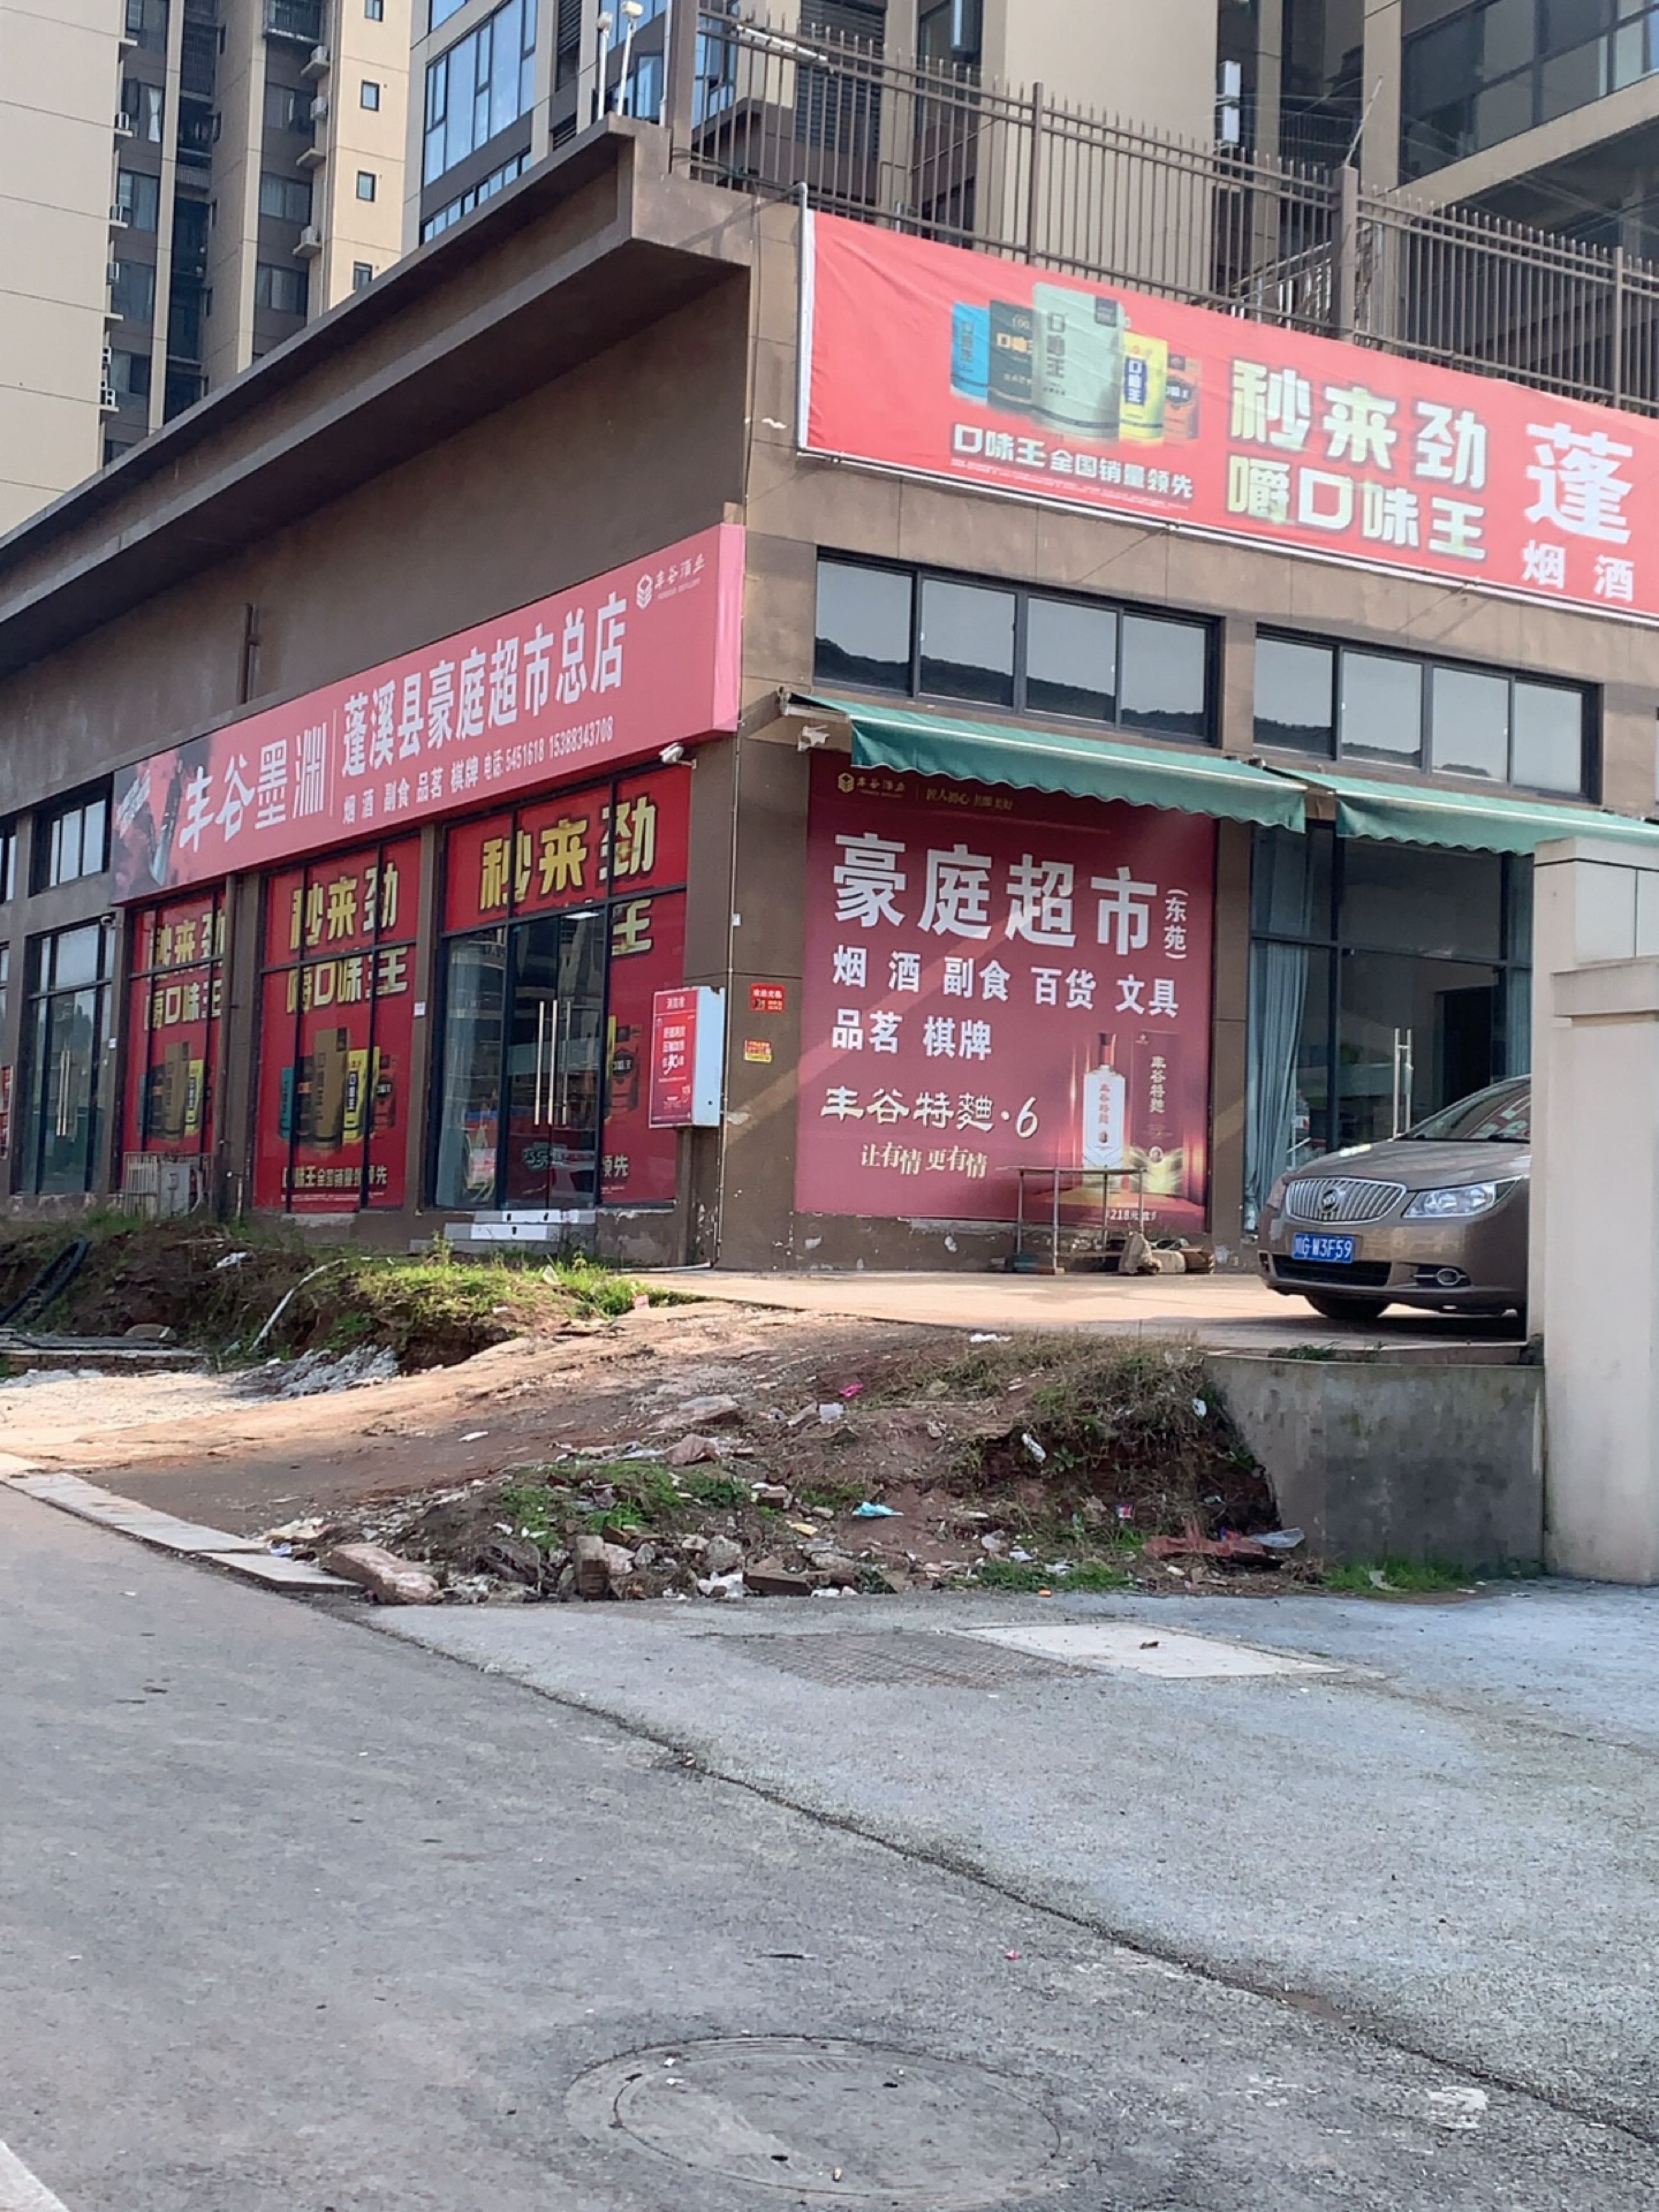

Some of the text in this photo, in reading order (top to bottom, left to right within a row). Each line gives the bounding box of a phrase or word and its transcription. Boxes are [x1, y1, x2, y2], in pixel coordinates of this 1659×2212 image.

[954, 423, 1194, 499] 口味王全国销量领先
[1231, 358, 1487, 489] 秒来劲
[1525, 422, 1633, 544] 蓬
[1228, 455, 1486, 560] 嚼口味王
[342, 591, 627, 778] 蓬溪县豪庭超市总店
[480, 796, 655, 910] 秒来劲
[833, 833, 1157, 956] 豪庭超市
